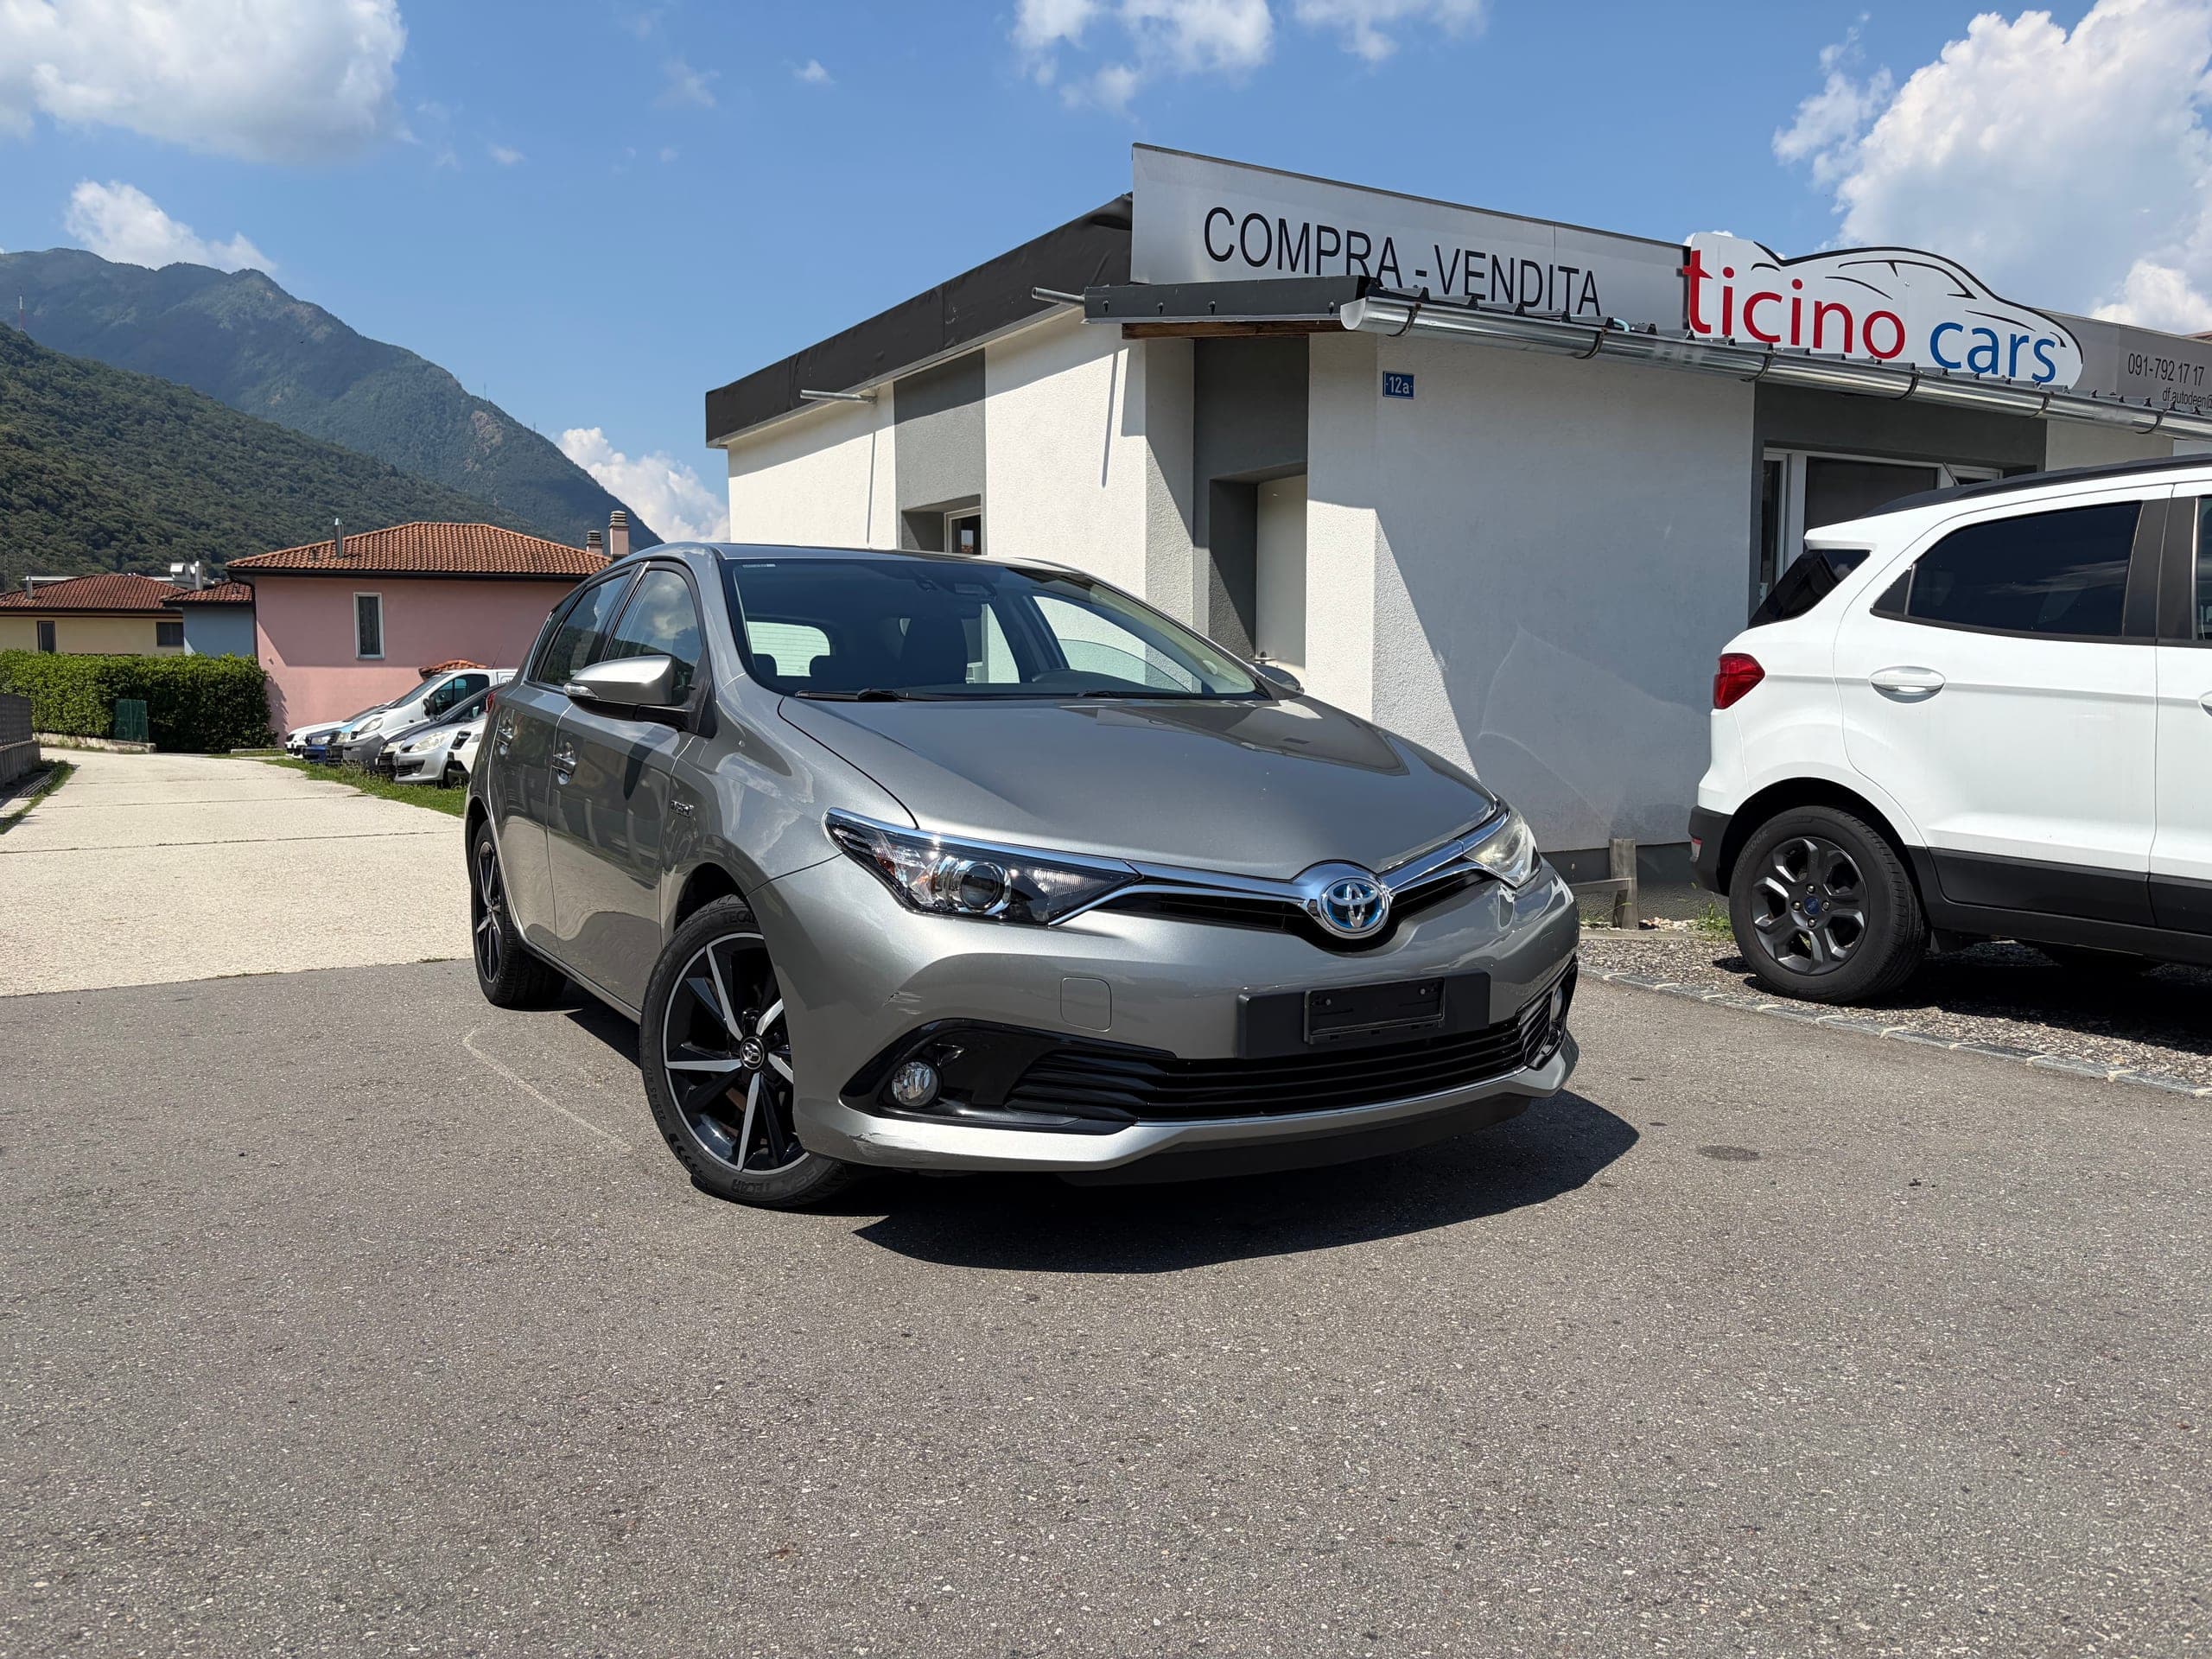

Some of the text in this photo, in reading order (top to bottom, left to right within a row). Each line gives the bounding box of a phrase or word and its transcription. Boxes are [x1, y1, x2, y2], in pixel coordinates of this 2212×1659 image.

[1204, 207, 1403, 289] COMPRA
[1433, 244, 1601, 316] VENDITA
[1682, 249, 2056, 384] ticino cars
[1389, 375, 1410, 394] 12a
[2127, 353, 2205, 387] 091-792 17 17
